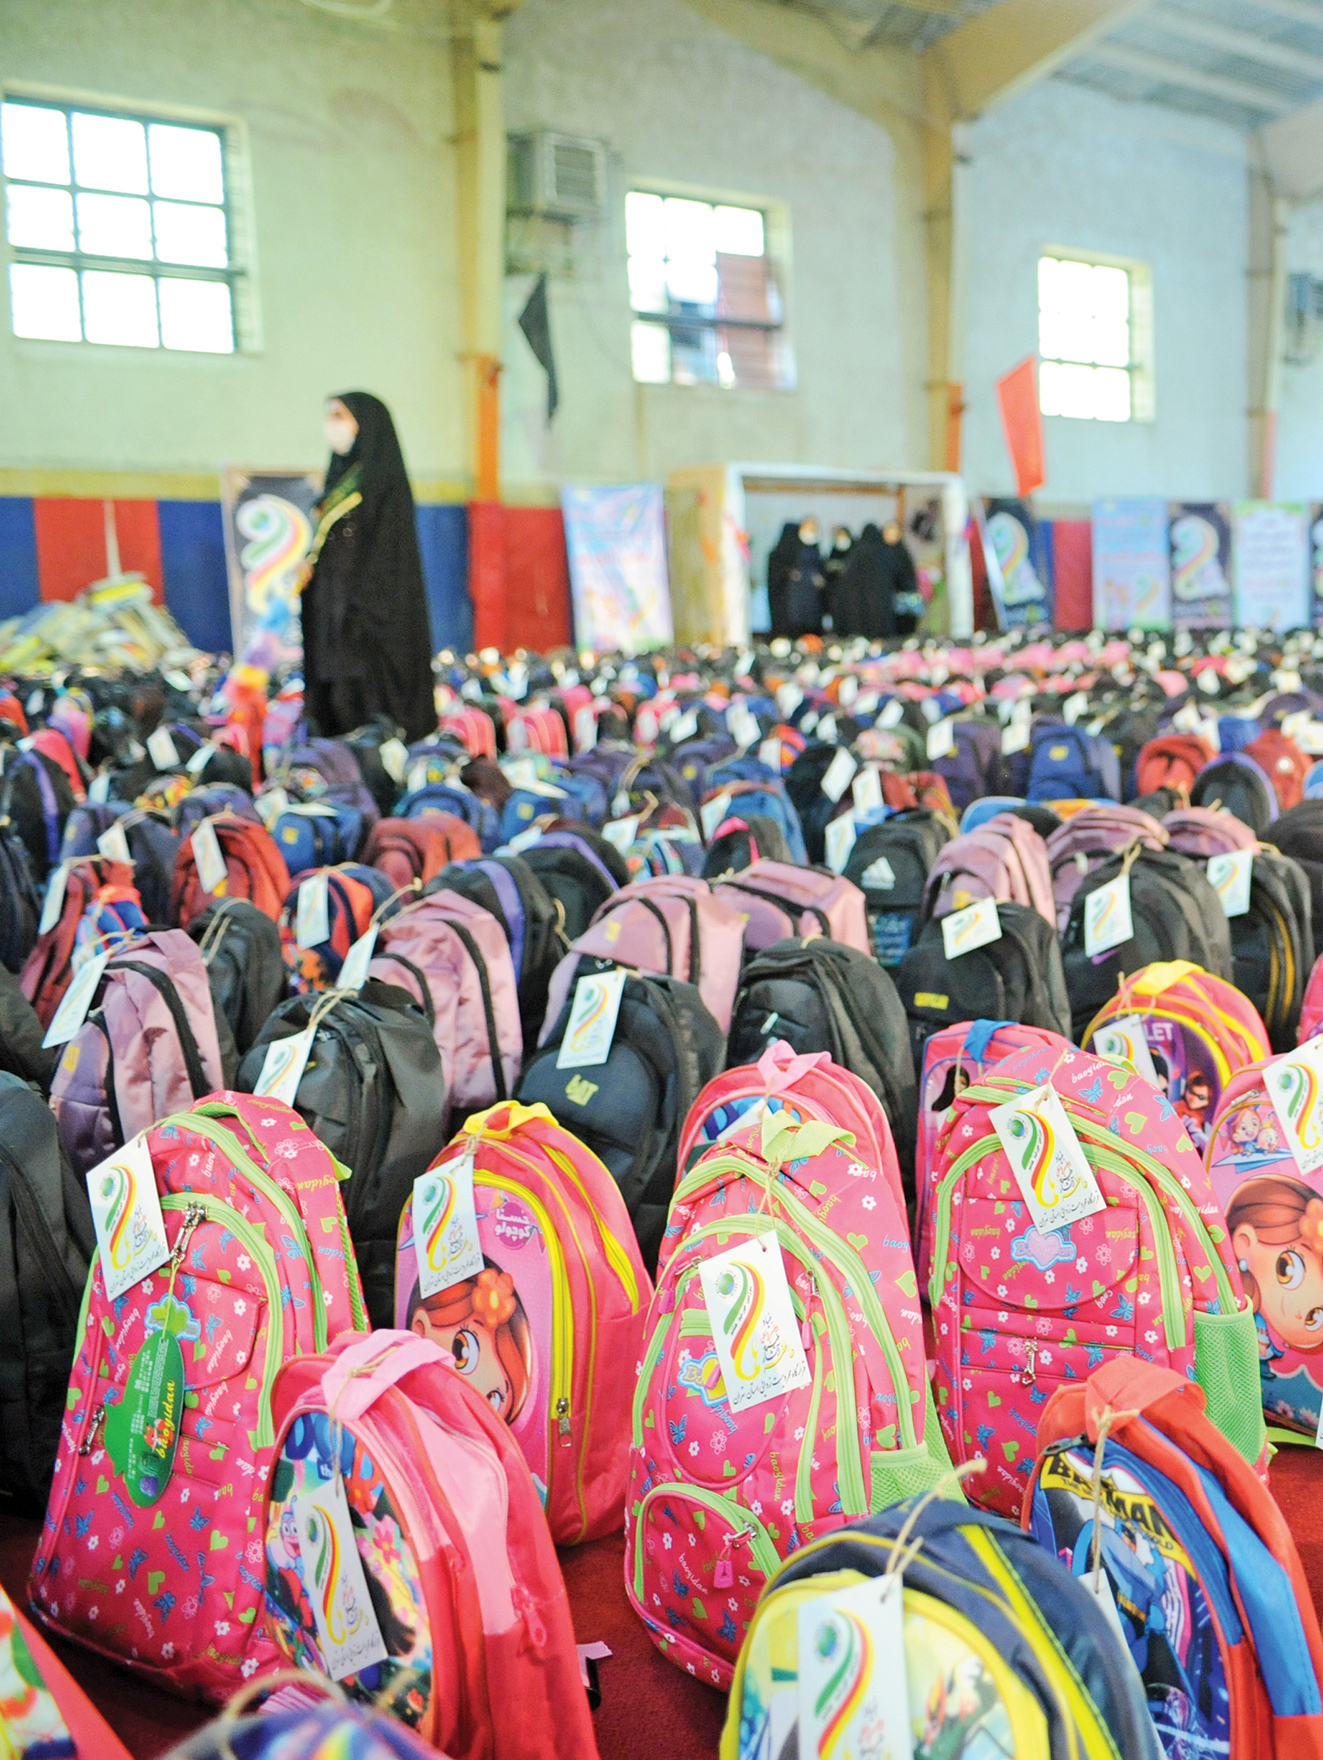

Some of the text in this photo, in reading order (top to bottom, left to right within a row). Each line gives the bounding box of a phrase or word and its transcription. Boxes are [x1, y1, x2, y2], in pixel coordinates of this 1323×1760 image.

[155, 1378, 177, 1460] baoyidan
[769, 1451, 786, 1502] baoyidan
[678, 1552, 709, 1595] baoyidan
